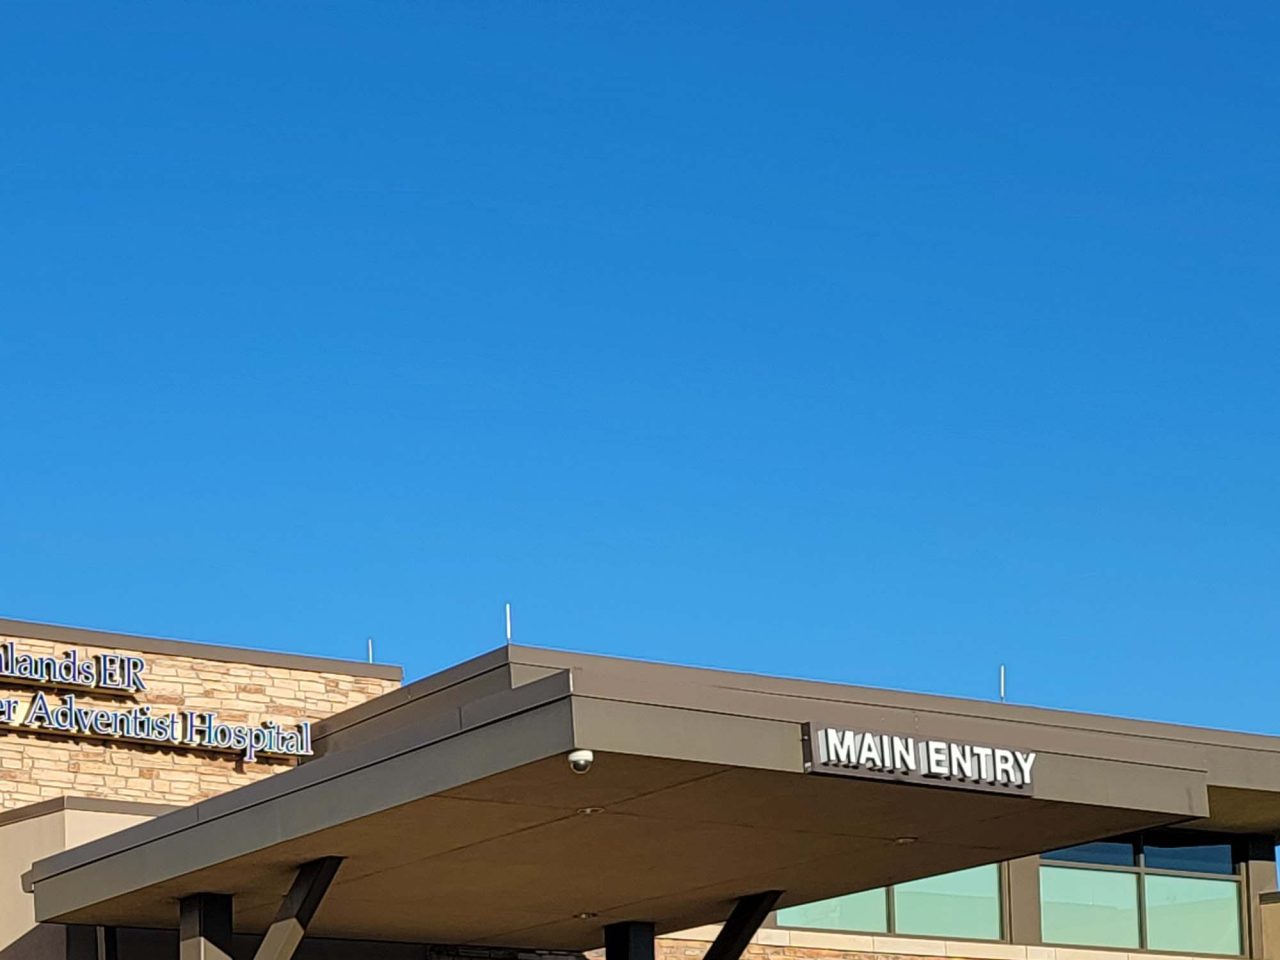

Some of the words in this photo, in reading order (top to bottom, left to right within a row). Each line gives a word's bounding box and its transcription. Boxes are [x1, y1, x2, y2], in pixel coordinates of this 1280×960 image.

[98, 653, 147, 691] ER
[27, 692, 179, 741] Adventist
[184, 710, 314, 761] Hospital
[820, 727, 916, 771] MAIN
[923, 740, 1036, 784] ENTRY
